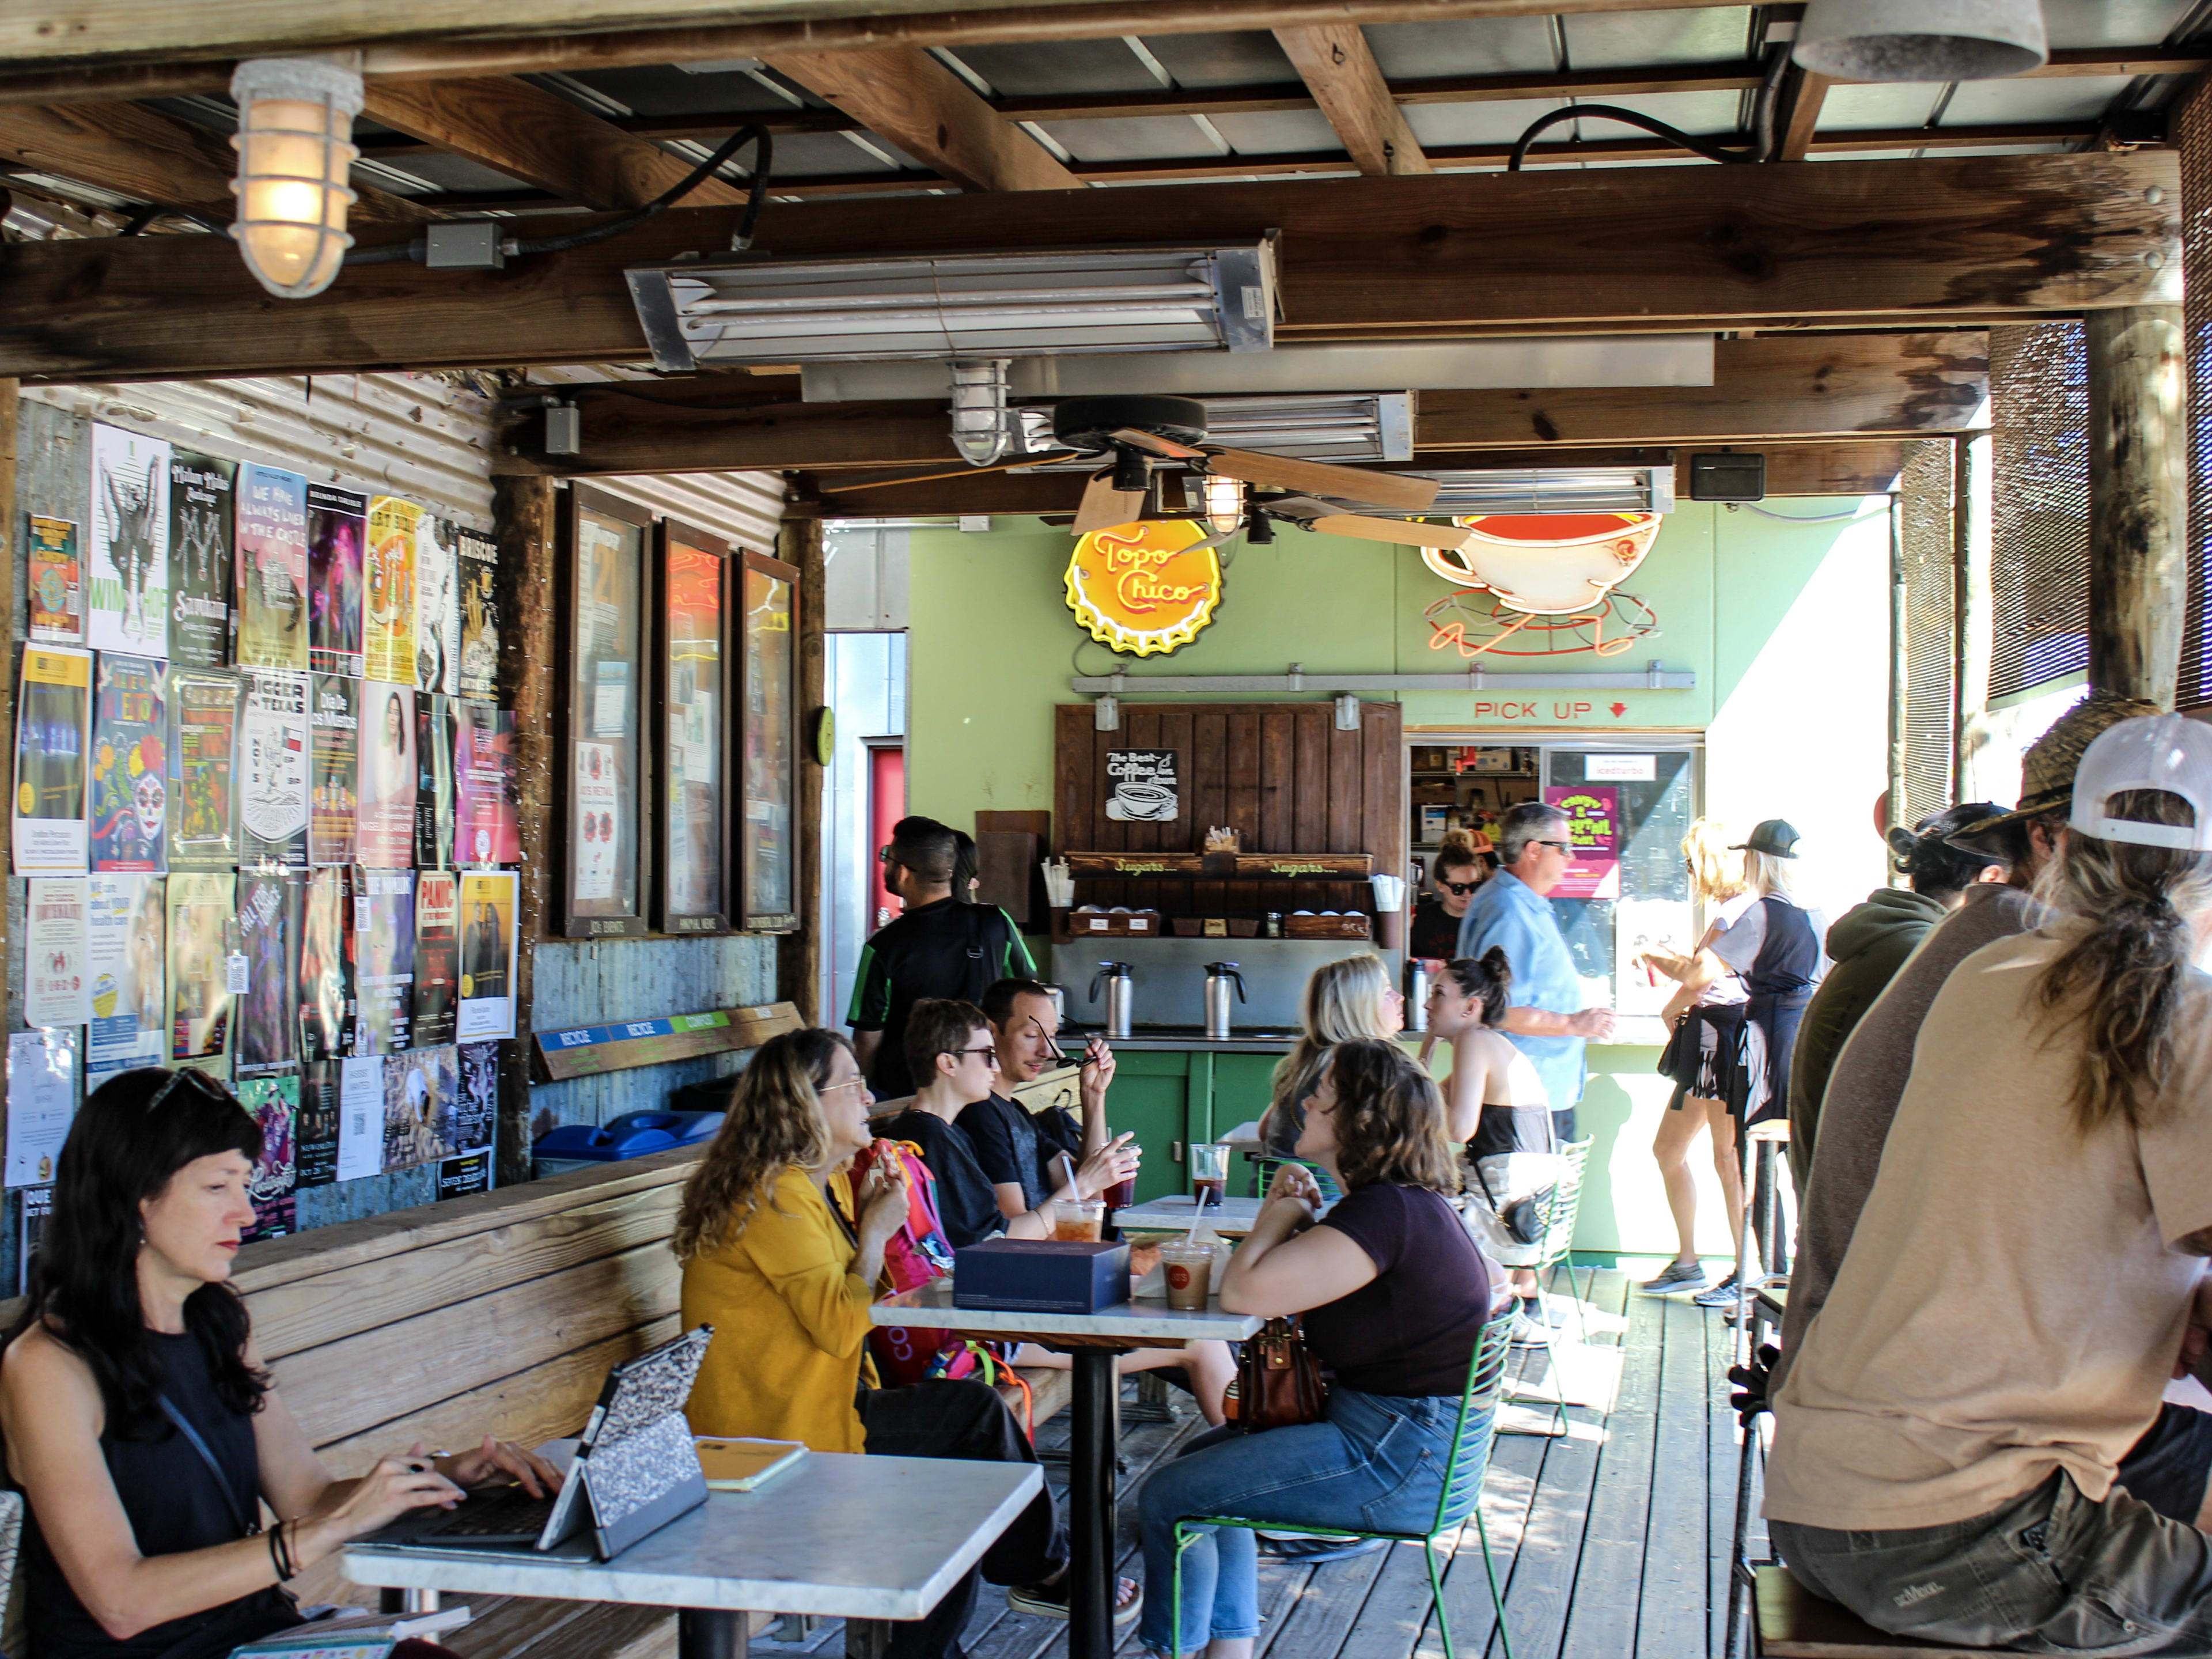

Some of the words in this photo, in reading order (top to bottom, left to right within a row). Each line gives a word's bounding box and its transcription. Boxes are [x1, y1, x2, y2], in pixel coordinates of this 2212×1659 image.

[1093, 525, 1180, 574] Topo
[1116, 569, 1209, 613] Chico
[262, 696, 305, 714] TEXAS
[1475, 702, 1537, 719] PICK
[1554, 702, 1592, 720] UP
[1106, 752, 1128, 763] The
[1106, 762, 1157, 782] Coffee
[111, 897, 130, 910] YOUR
[421, 880, 454, 909] PANIC
[90, 914, 113, 926] health
[113, 916, 129, 926] care
[559, 1029, 593, 1047] RECYCLE
[626, 1021, 657, 1037] RECYCLE
